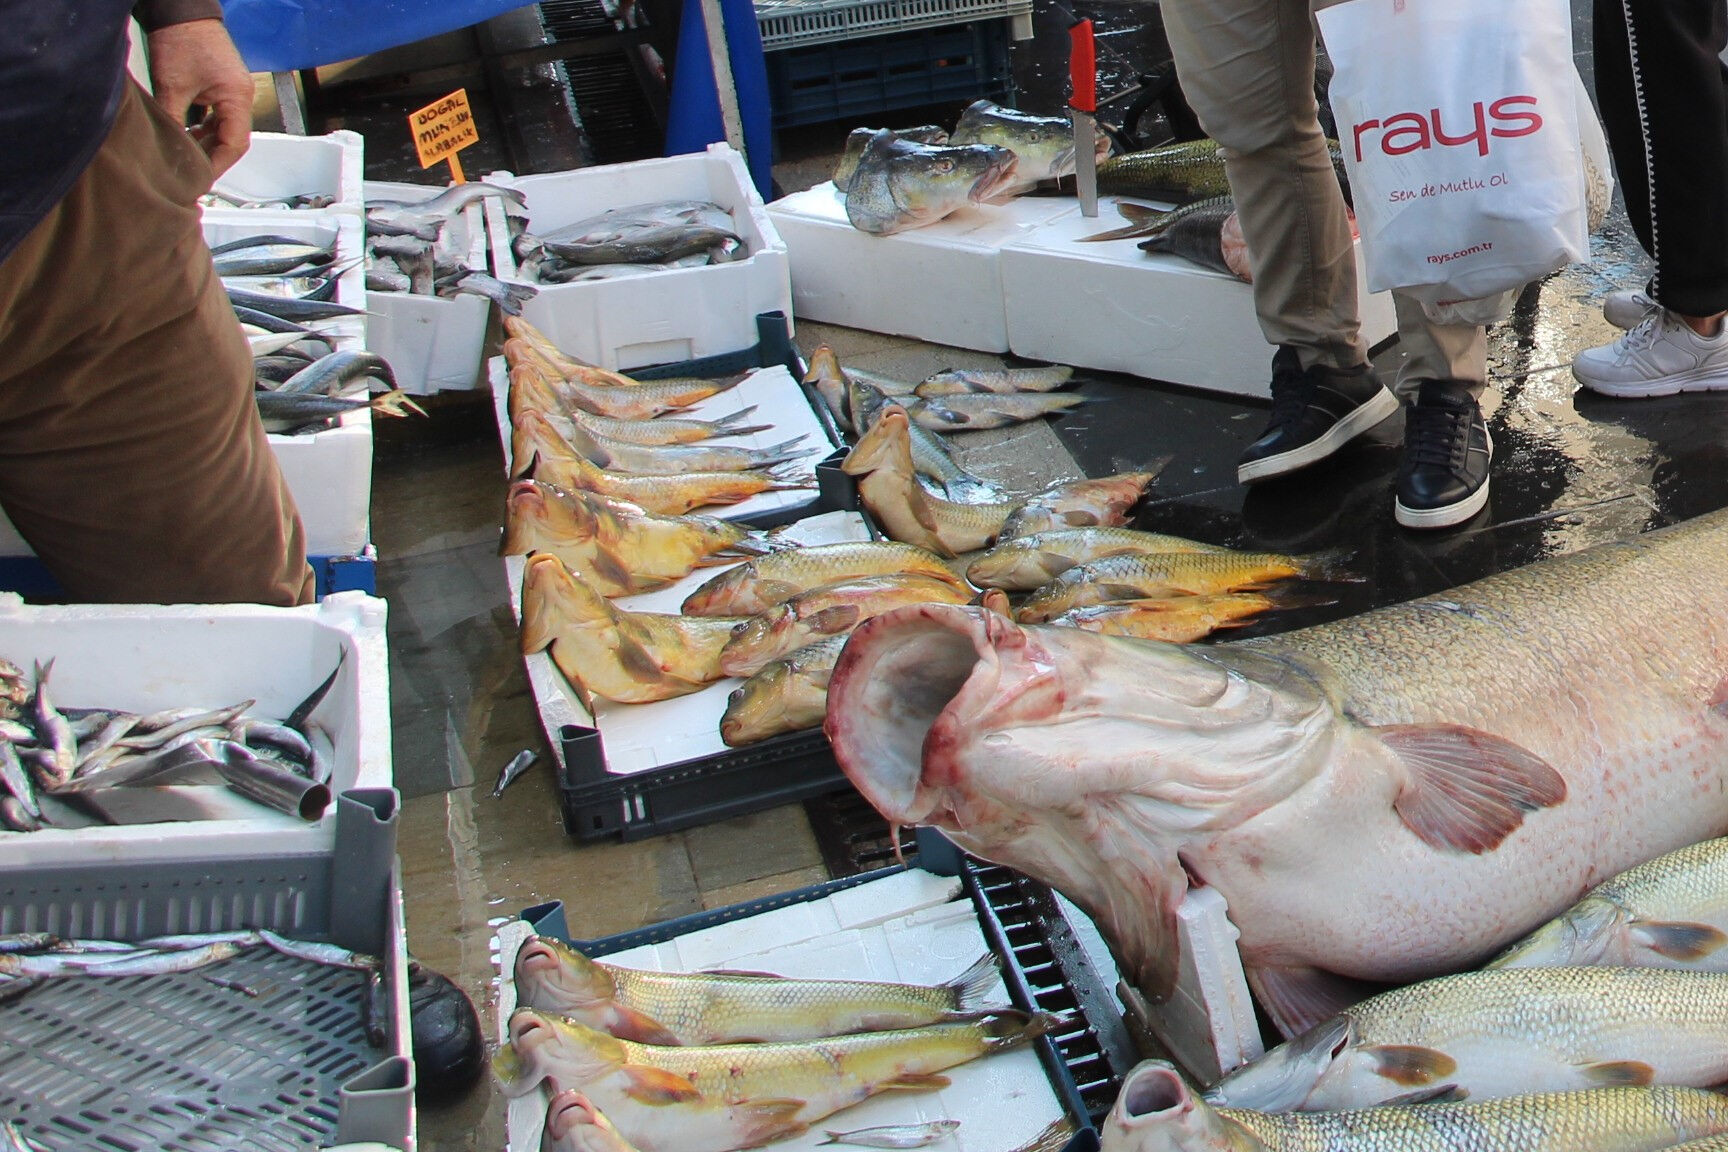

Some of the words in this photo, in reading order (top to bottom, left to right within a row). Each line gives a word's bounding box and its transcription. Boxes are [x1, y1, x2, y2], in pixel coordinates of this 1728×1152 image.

[1352, 94, 1543, 163] rays
[1388, 189, 1418, 203] Sen
[1420, 183, 1436, 197] de
[1439, 177, 1485, 196] Mutlu
[1489, 172, 1509, 187] Ol
[1426, 241, 1493, 265] rays.com.tr
